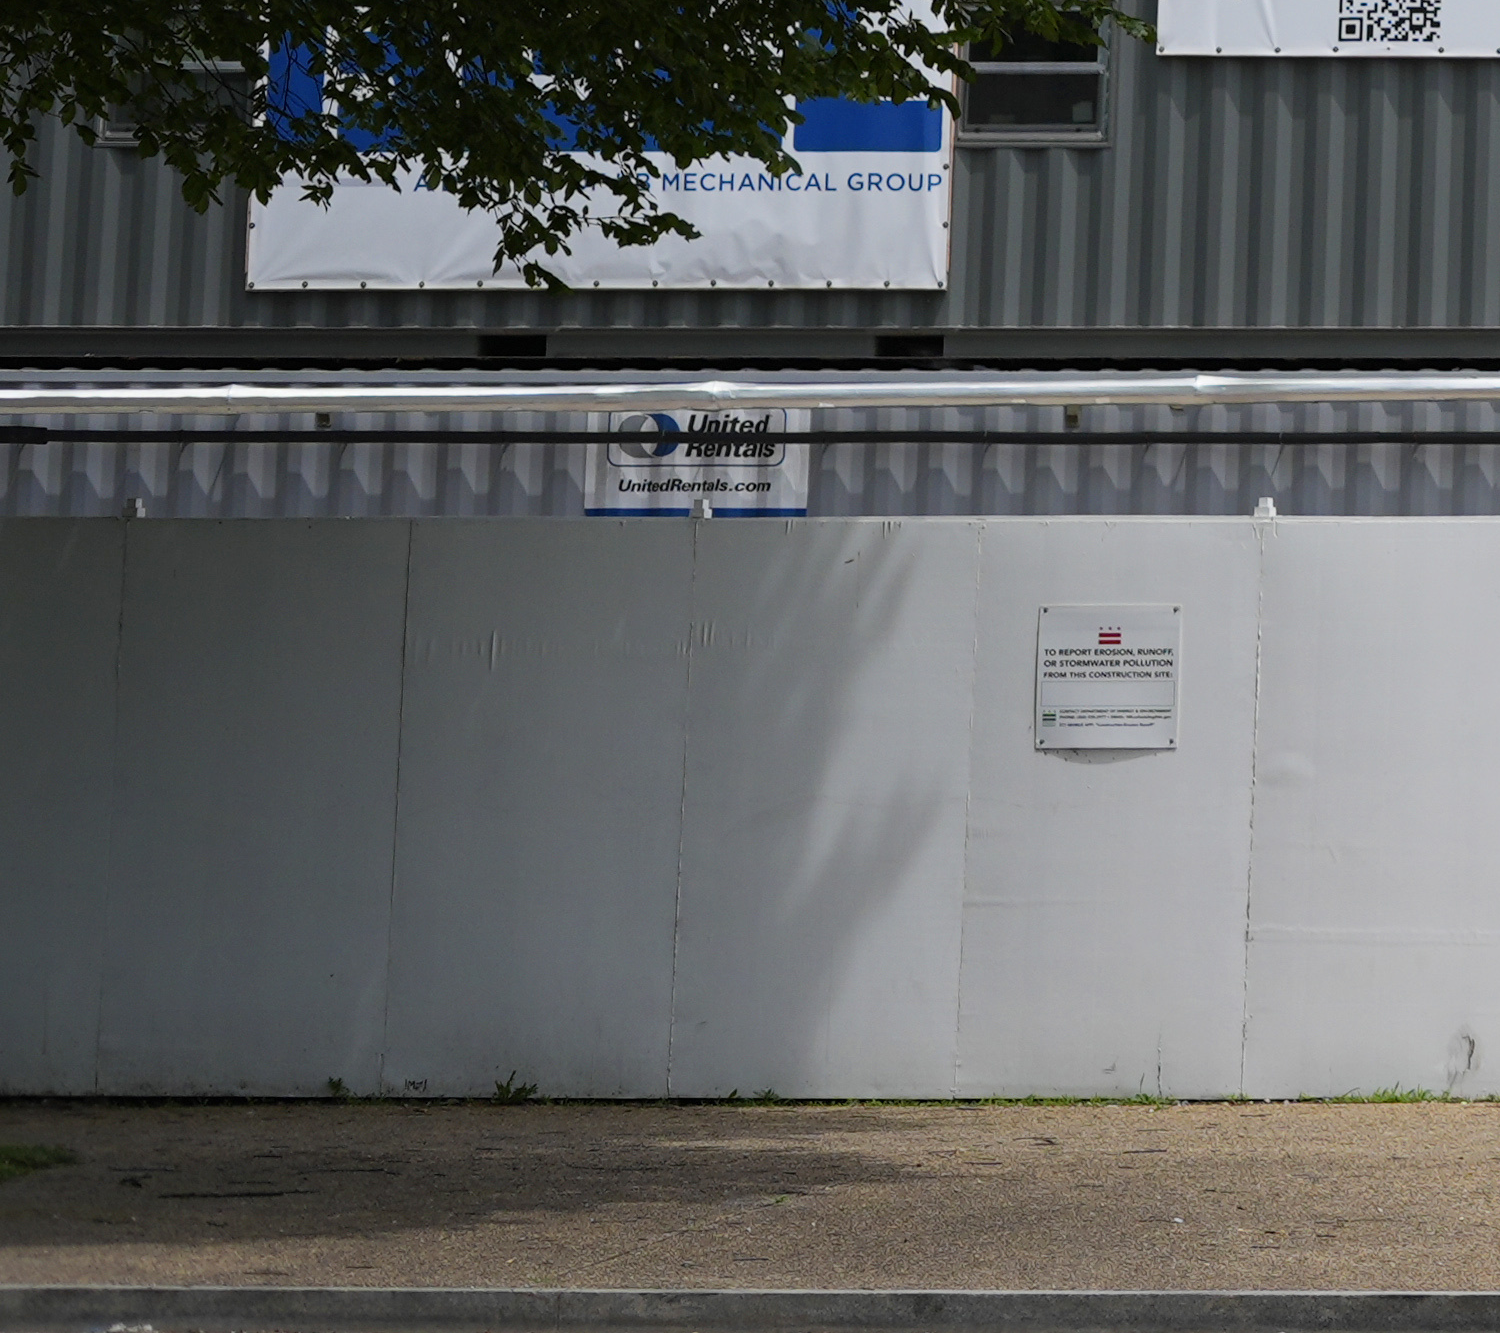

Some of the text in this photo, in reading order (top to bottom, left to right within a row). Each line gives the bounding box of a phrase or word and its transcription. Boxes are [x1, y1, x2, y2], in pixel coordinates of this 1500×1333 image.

[662, 172, 838, 193] MECHANICAL
[846, 172, 942, 193] GROUP
[687, 414, 771, 433] United
[618, 478, 772, 493] UnitedRentals.com
[1044, 648, 1174, 658] TO REPORT EROSION, RUNOFF,
[1043, 659, 1173, 668] OR STORMWATER POLLUTION
[1088, 671, 1152, 679] CONSTRUCTION
